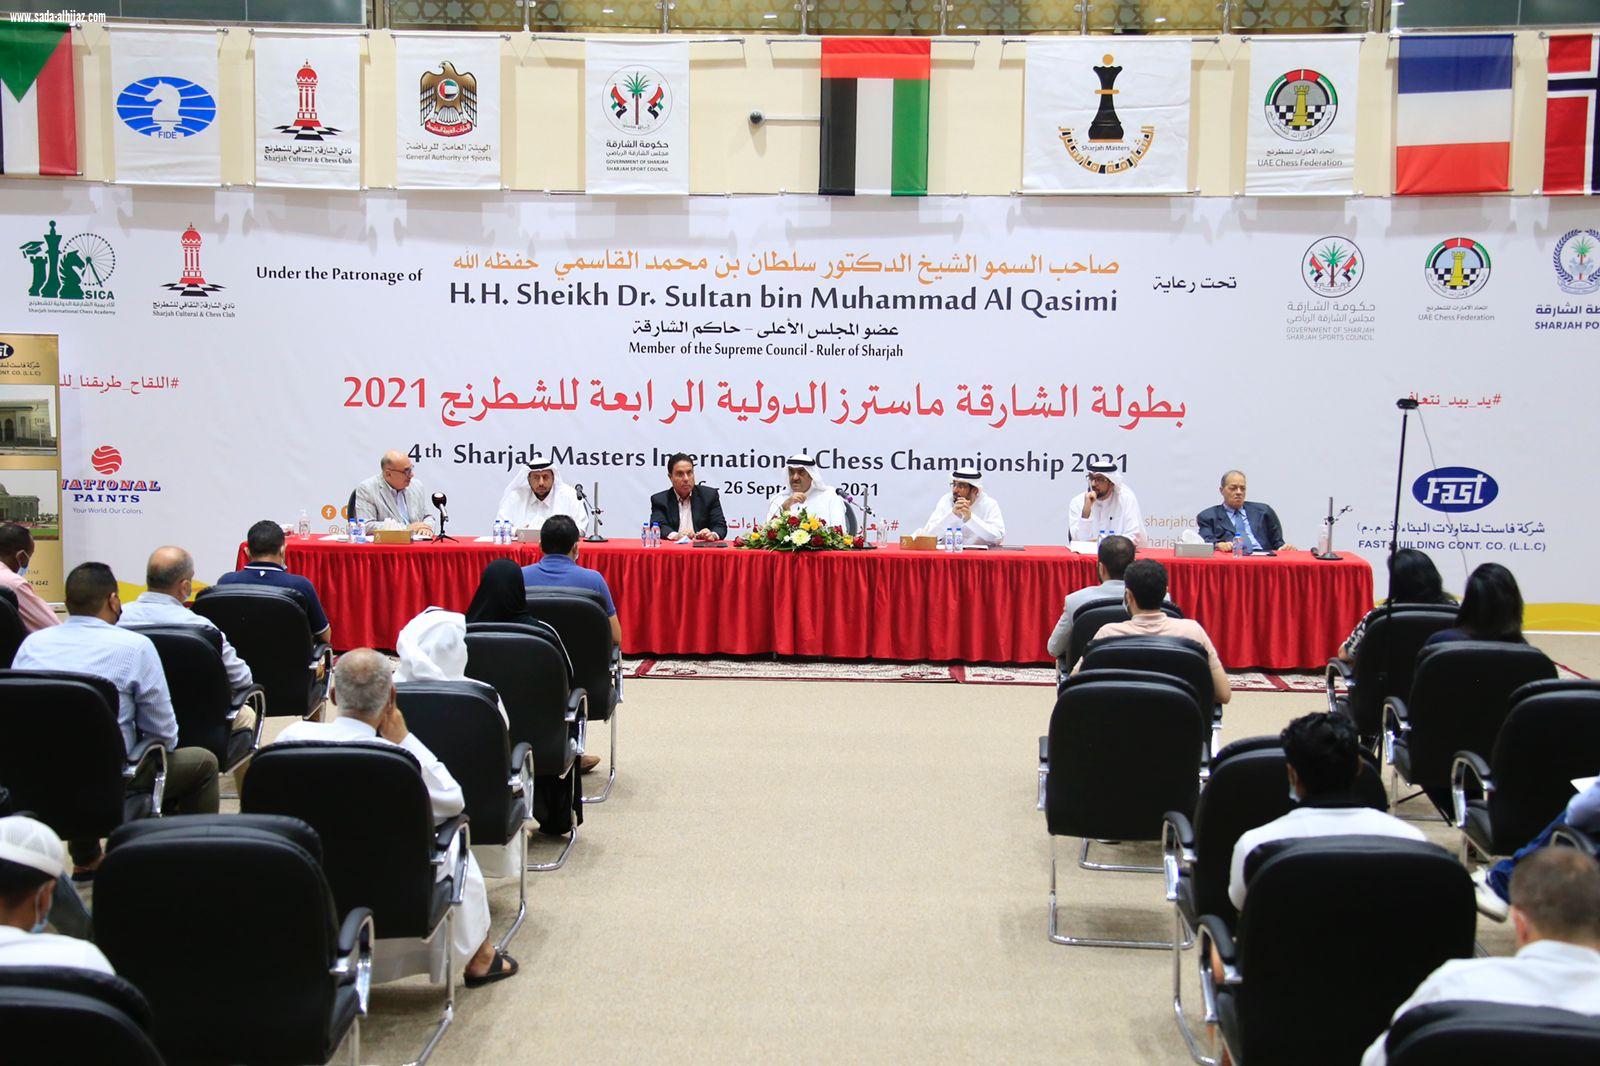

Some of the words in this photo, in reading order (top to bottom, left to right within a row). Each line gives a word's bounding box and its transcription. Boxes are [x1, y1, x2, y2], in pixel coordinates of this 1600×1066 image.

[158, 131, 177, 140] FIDE
[606, 140, 638, 149] الشارقة
[639, 141, 669, 150] حكومة
[264, 155, 288, 163] Sharjah
[431, 154, 461, 162] Authority
[471, 155, 492, 163] Sports
[1257, 159, 1274, 167] UAE
[1275, 159, 1298, 167] Chess
[1300, 159, 1343, 167] Federation
[453, 250, 479, 270] الله
[484, 252, 540, 270] حفظه
[554, 248, 639, 281] القاسمي
[645, 256, 708, 271] محمد
[747, 250, 816, 276] سلطان
[820, 252, 912, 280] الدكتور
[982, 254, 1043, 280] السمو
[1049, 254, 1120, 282] صاحب
[256, 266, 301, 279] Under
[305, 267, 328, 280] the
[332, 268, 405, 286] Patronage
[408, 268, 423, 282] of
[714, 258, 741, 279] بن
[917, 252, 977, 285] الشيخ
[1152, 275, 1196, 294] رعاية
[1200, 276, 1237, 289] تحت
[85, 290, 115, 300] SICA
[516, 281, 609, 306] Sheikh
[618, 285, 656, 306] Dr.
[665, 284, 751, 308] Sultan
[761, 285, 801, 309] bin
[811, 286, 977, 311] Muhammad
[984, 287, 1012, 311] Al
[1020, 288, 1117, 319] Qasimi
[1287, 301, 1330, 314] الشارقة
[1333, 301, 1376, 314] حكومة
[1535, 301, 1582, 318] الشارقة
[1317, 314, 1347, 324] الشارقة
[1348, 314, 1375, 324] مجلس
[1434, 313, 1456, 321] Chess
[1457, 313, 1495, 321] Federation
[632, 320, 688, 336] الشارقة
[692, 321, 741, 337] حاكم
[757, 319, 804, 339] الأعلى
[807, 322, 859, 340] المجلس
[862, 325, 899, 340] عضو
[1535, 321, 1583, 330] SHARJAH
[628, 341, 675, 355] Member
[680, 342, 693, 355] of
[694, 342, 712, 355] the
[714, 342, 763, 359] Supreme
[765, 342, 807, 356] Council
[816, 343, 846, 356] Ruler
[848, 343, 860, 356] of
[861, 342, 904, 361] Sharjah
[343, 376, 426, 408] 2021
[440, 375, 580, 427] للشطرنج
[716, 379, 828, 424] الدولية
[830, 382, 945, 425] ماسترز
[956, 382, 1078, 429] الشارقة
[1091, 383, 1186, 431] بطولة
[407, 443, 443, 463] 4th
[550, 446, 646, 467] Masters
[815, 447, 884, 470] Chess
[724, 480, 743, 495] 26
[73, 493, 140, 503] PAINTS
[1144, 514, 1195, 530] sharjahc
[1401, 523, 1430, 536] البناء
[1432, 523, 1480, 537] لمقاولات
[1481, 521, 1516, 533] فاست
[1518, 521, 1545, 536] شركة
[1358, 540, 1387, 549] FAST
[1399, 541, 1445, 550] UILDING
[1448, 541, 1482, 550] CONT.
[1485, 541, 1505, 550] CO.
[1509, 542, 1546, 551] (L.L.C)
